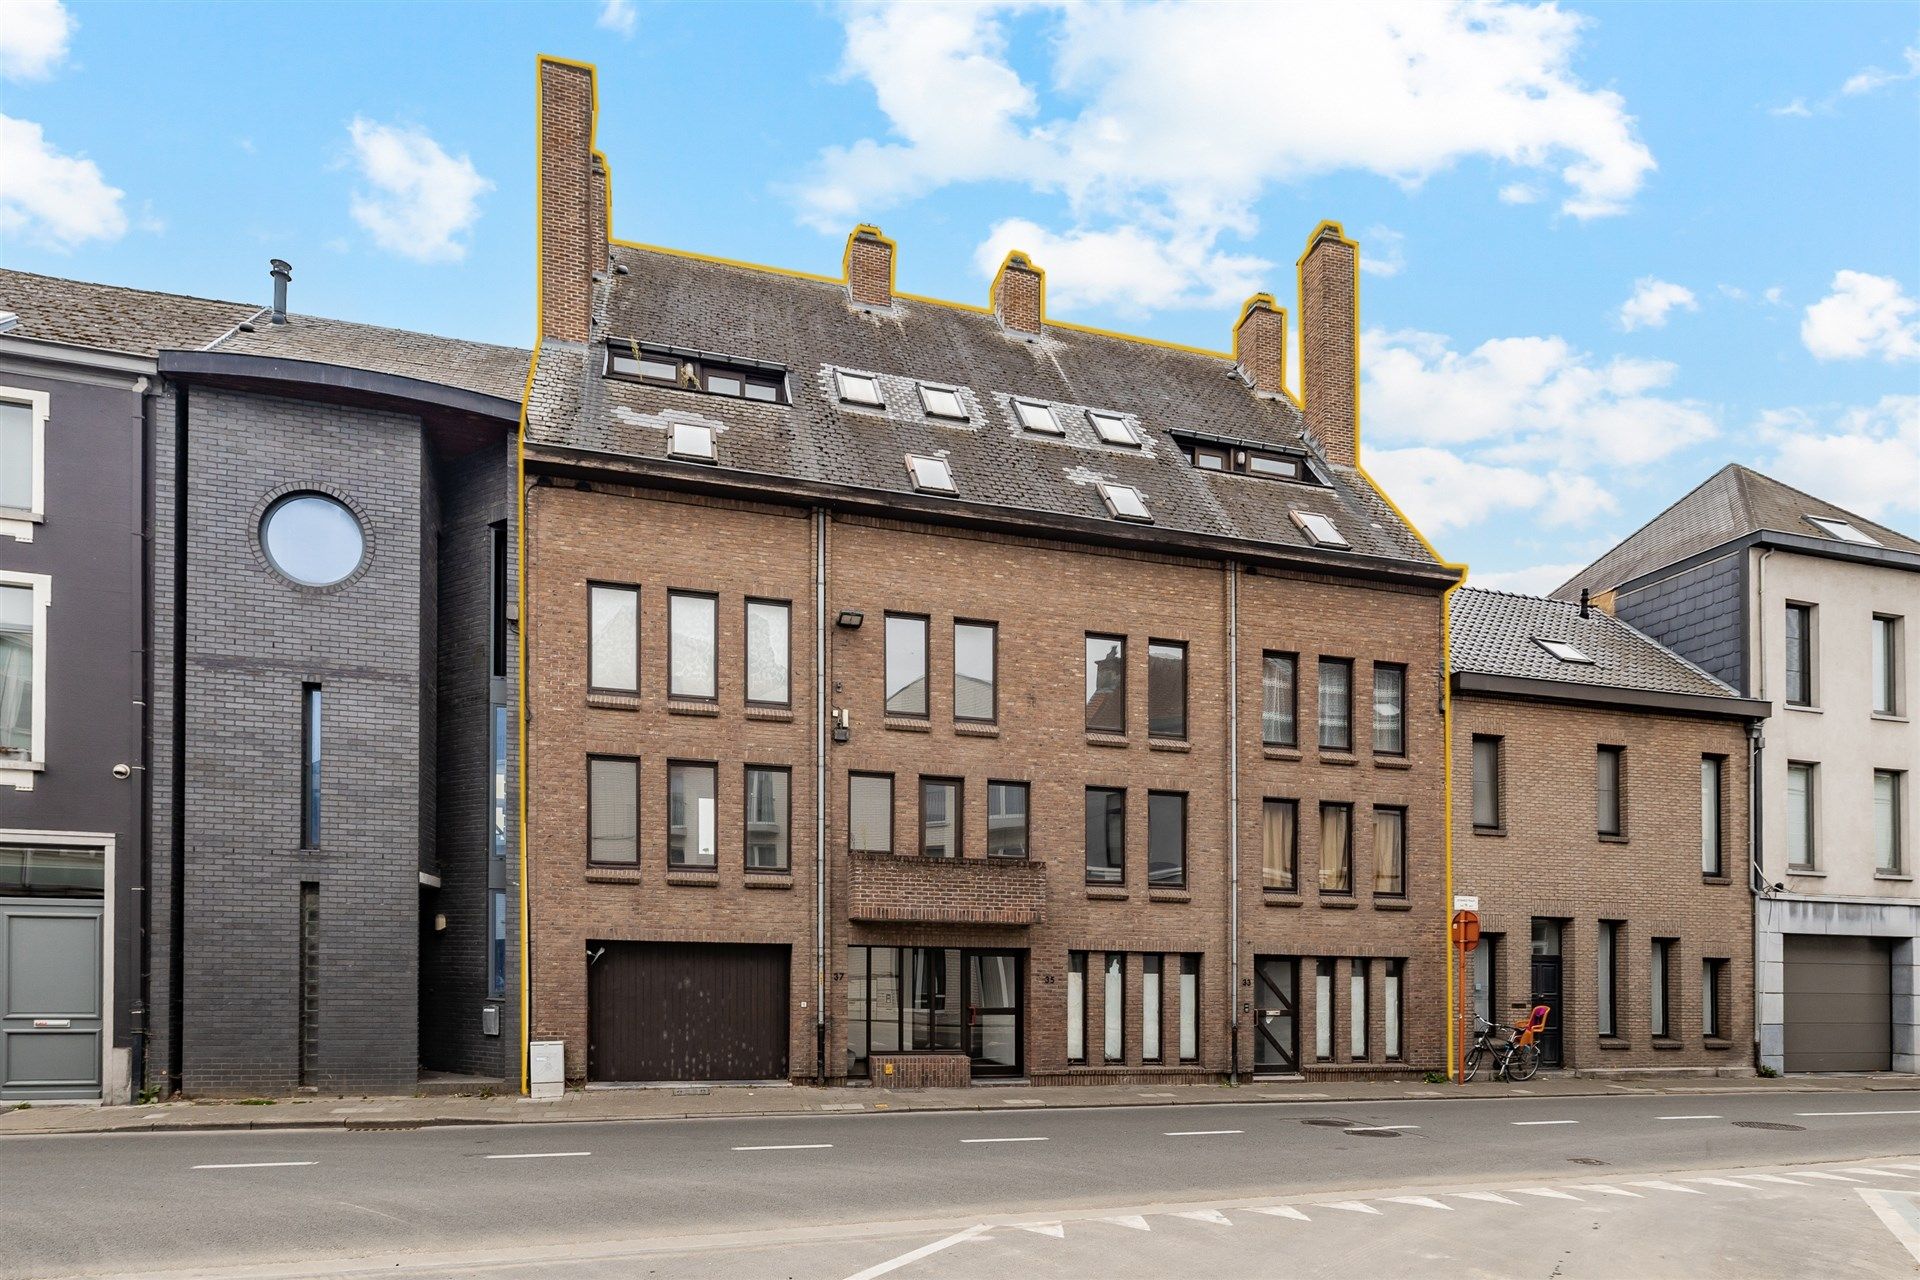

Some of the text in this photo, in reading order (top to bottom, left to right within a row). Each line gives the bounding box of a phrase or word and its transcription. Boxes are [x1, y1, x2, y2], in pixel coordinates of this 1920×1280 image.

[833, 972, 845, 981] 37
[1044, 975, 1055, 984] 35
[1242, 978, 1251, 986] 33
